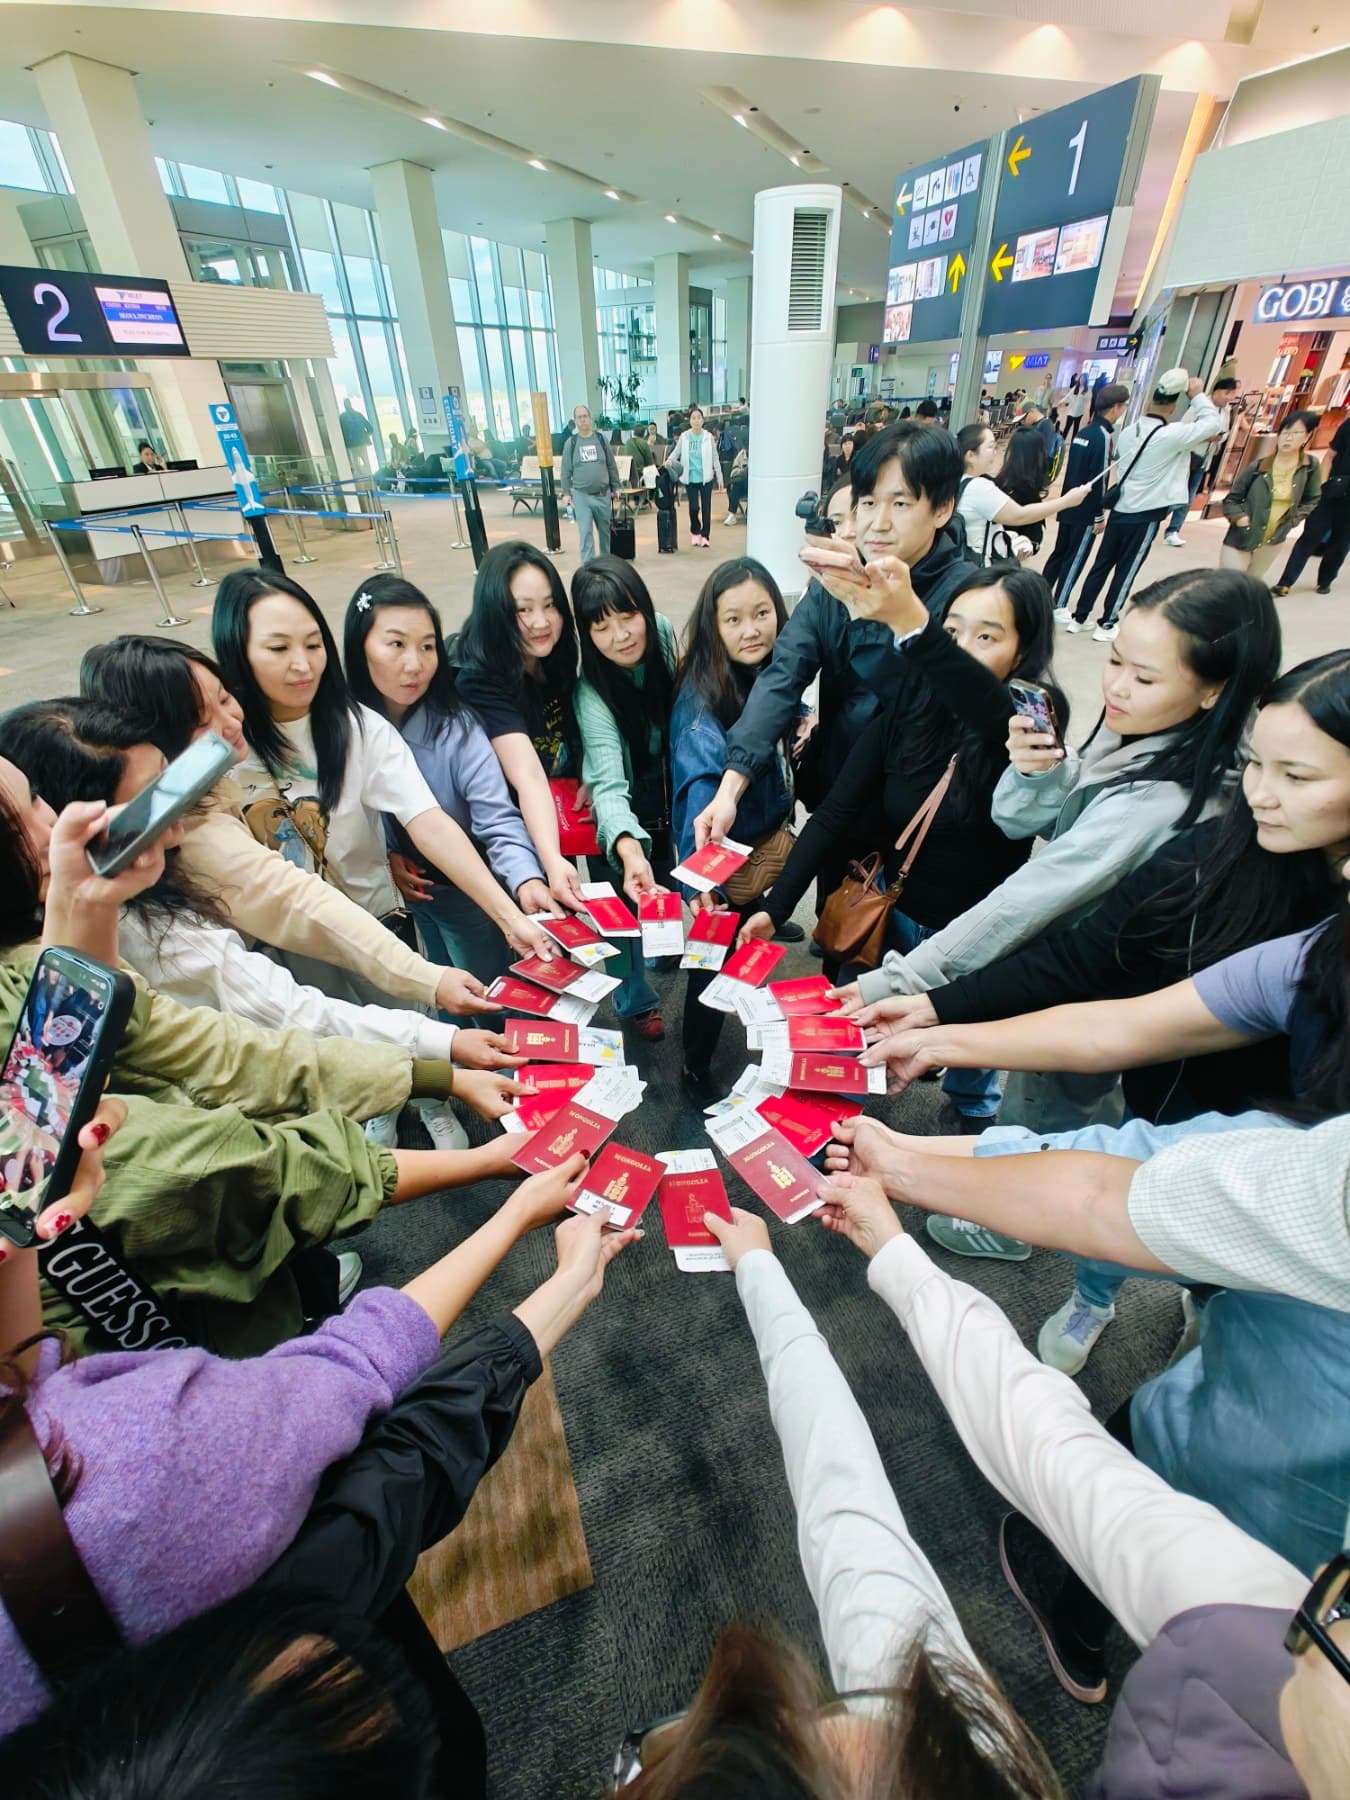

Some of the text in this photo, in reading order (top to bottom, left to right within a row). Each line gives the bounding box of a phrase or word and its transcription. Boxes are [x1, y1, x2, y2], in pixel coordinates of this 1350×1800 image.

[1068, 120, 1088, 195] 1
[34, 283, 83, 342] 2
[1258, 280, 1340, 318] GOBI
[1025, 355, 1048, 368] MIAT
[443, 399, 458, 449] ECONOMY
[614, 1153, 652, 1172] MONGOLIA
[47, 1243, 171, 1348] GUESS
